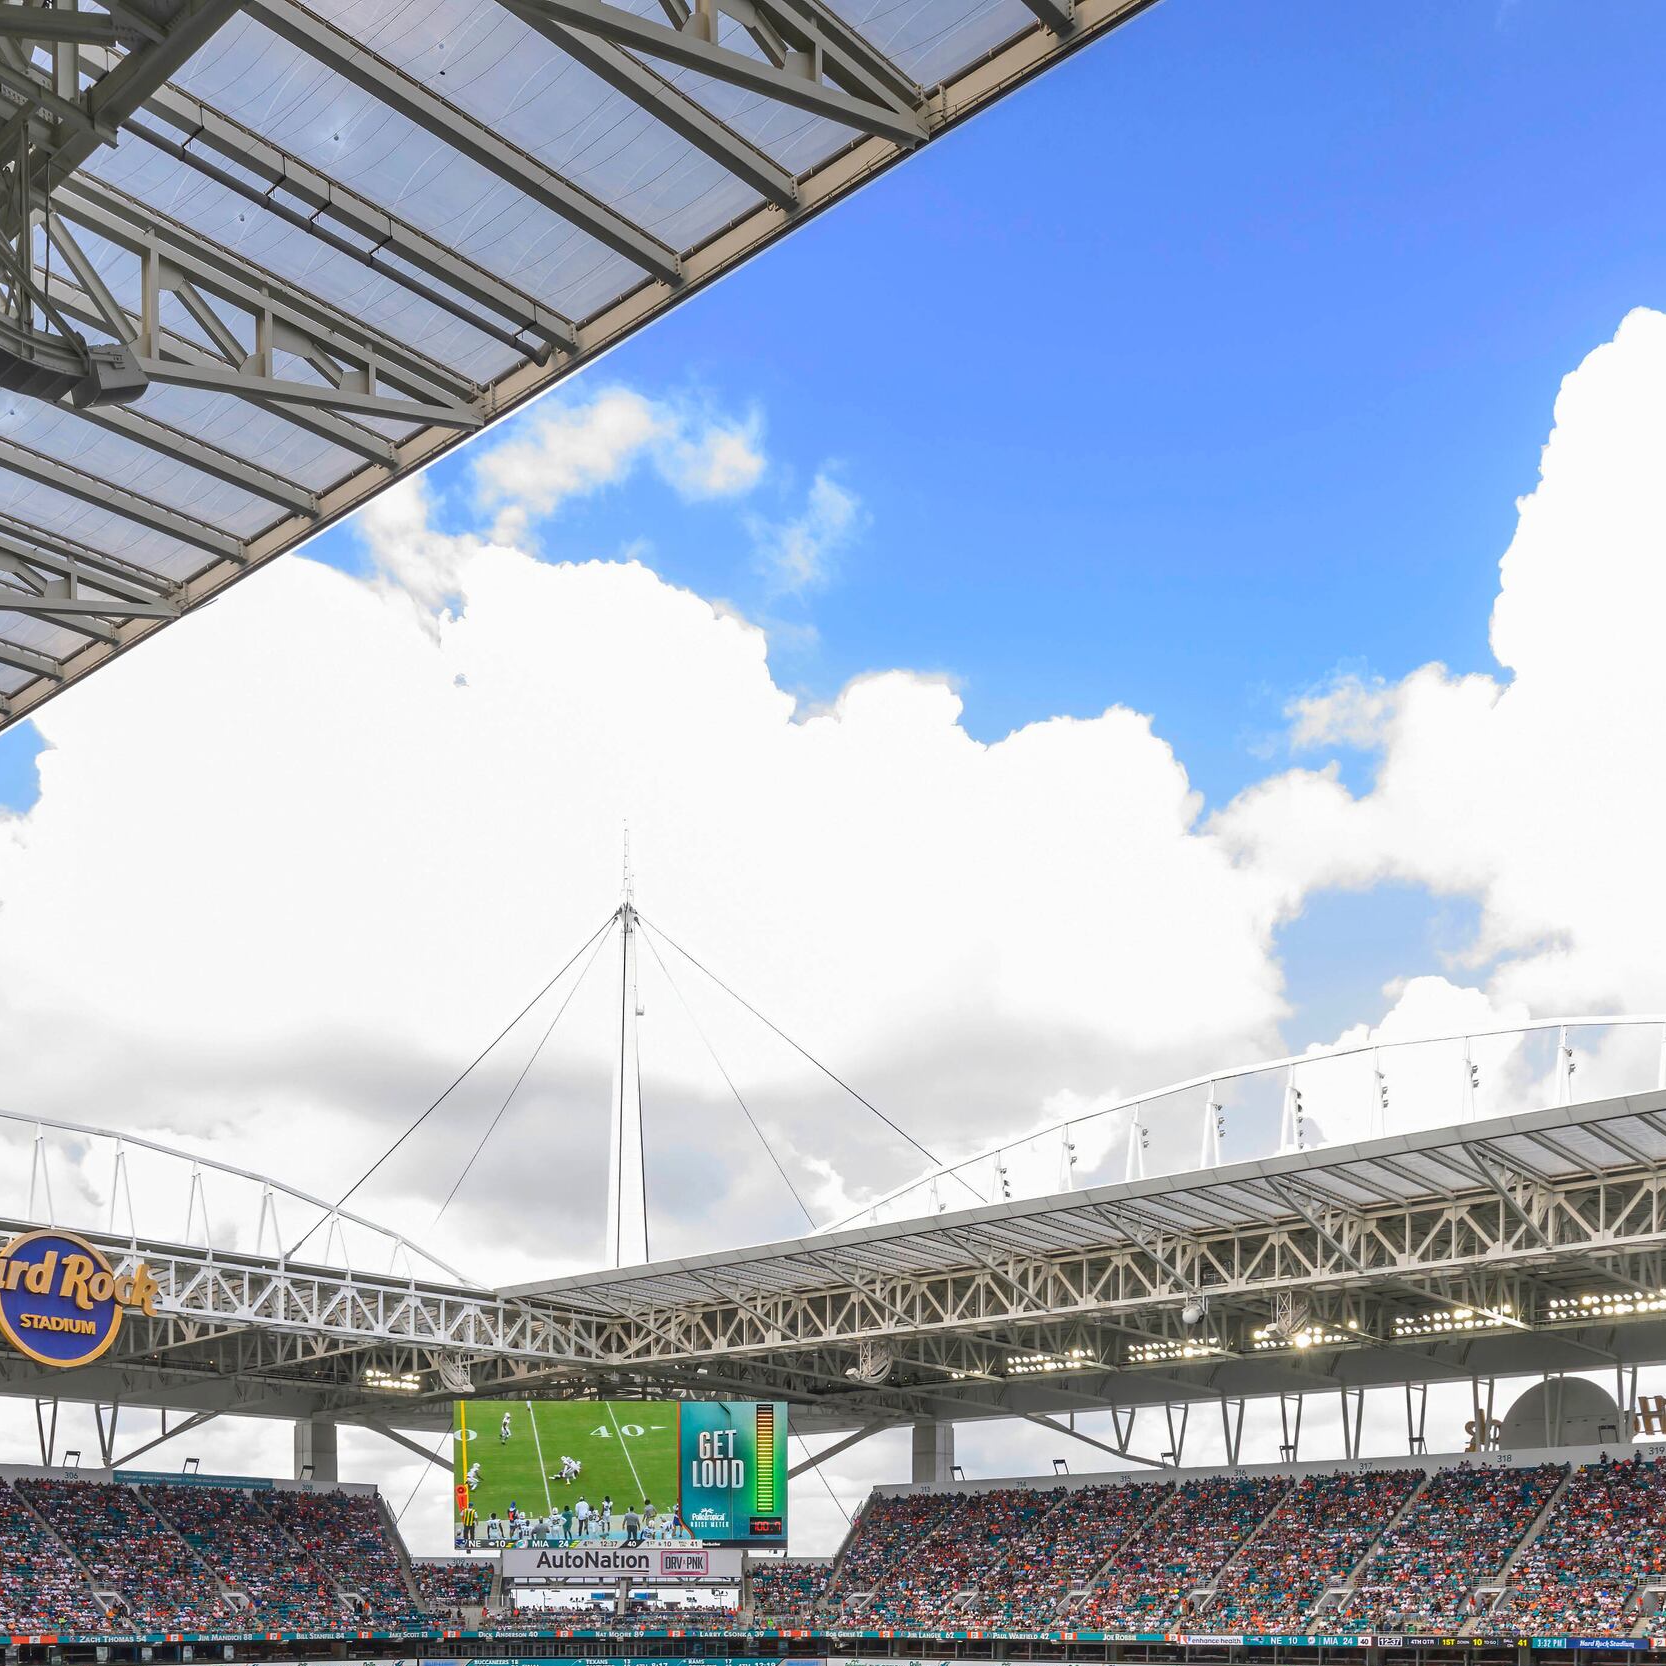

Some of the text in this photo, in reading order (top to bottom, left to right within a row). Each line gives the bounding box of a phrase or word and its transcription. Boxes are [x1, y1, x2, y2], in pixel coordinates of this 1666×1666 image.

[59, 1253, 159, 1318] Rock
[19, 1313, 97, 1335] STADIUM
[589, 1424, 645, 1439] 40
[699, 1429, 737, 1460] GET
[692, 1459, 745, 1489] LOUD
[749, 1520, 782, 1533] 100.7
[468, 1539, 506, 1548] NE 10
[532, 1539, 570, 1548] MIA 24
[536, 1550, 650, 1569] AutoNation
